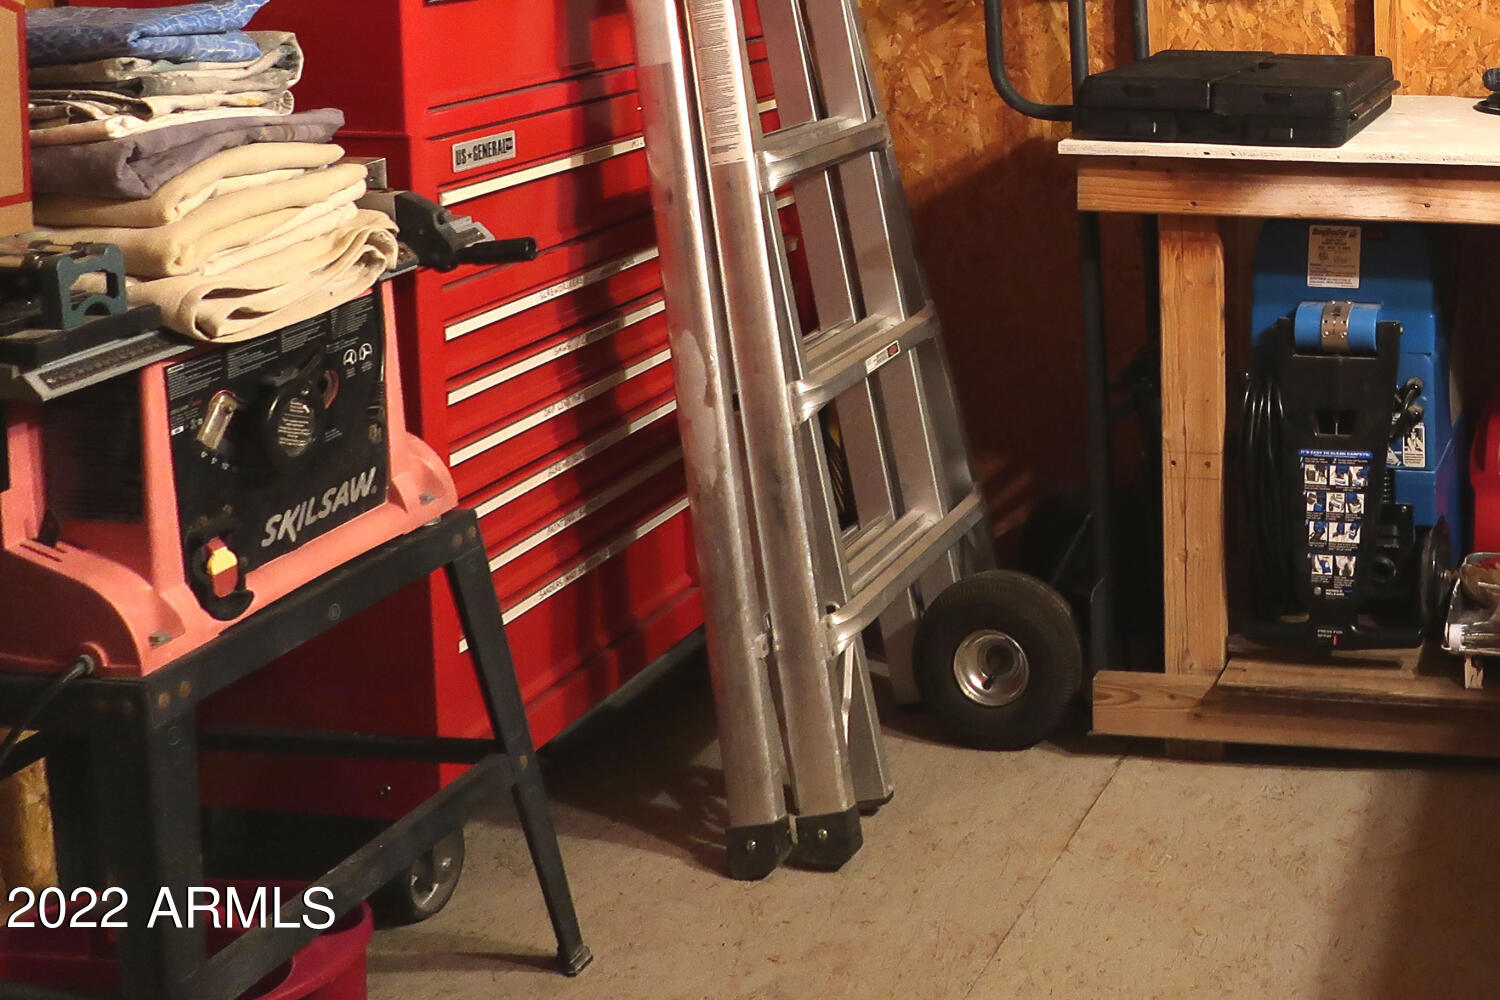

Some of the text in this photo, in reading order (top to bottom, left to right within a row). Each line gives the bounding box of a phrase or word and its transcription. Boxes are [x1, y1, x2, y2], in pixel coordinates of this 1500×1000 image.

[455, 149, 467, 166] US
[472, 138, 506, 162] GENERAL
[260, 466, 378, 548] SKILSAW
